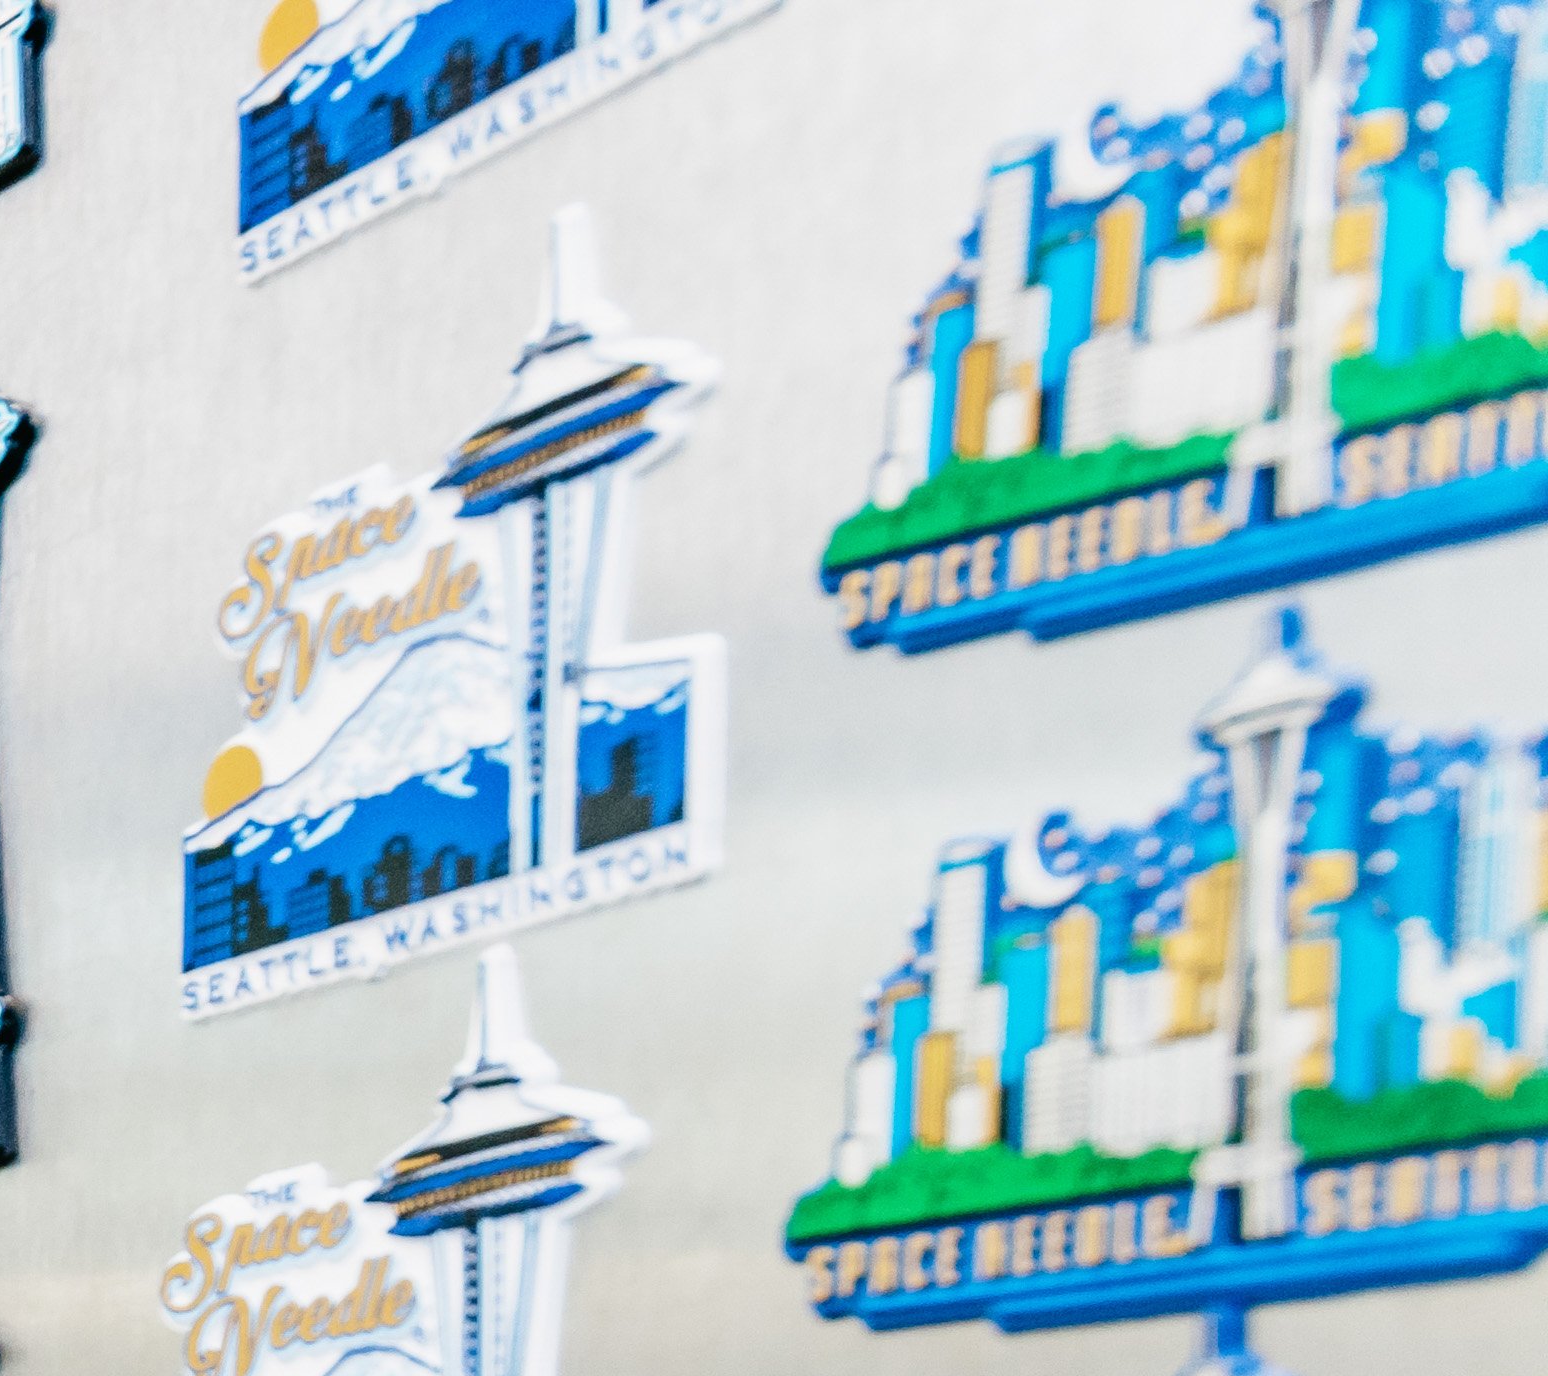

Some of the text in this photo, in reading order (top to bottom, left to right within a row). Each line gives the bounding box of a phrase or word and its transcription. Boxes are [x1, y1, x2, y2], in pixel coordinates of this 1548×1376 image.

[238, 0, 728, 272] SEATTLE, WASHINGTO
[219, 495, 415, 640] Space
[243, 540, 483, 722] Needle
[838, 535, 1002, 629] SPACE
[182, 836, 687, 1011] SEATTLE, WASHINGTON
[161, 1201, 351, 1312] Space
[804, 1226, 963, 1304] SPACE
